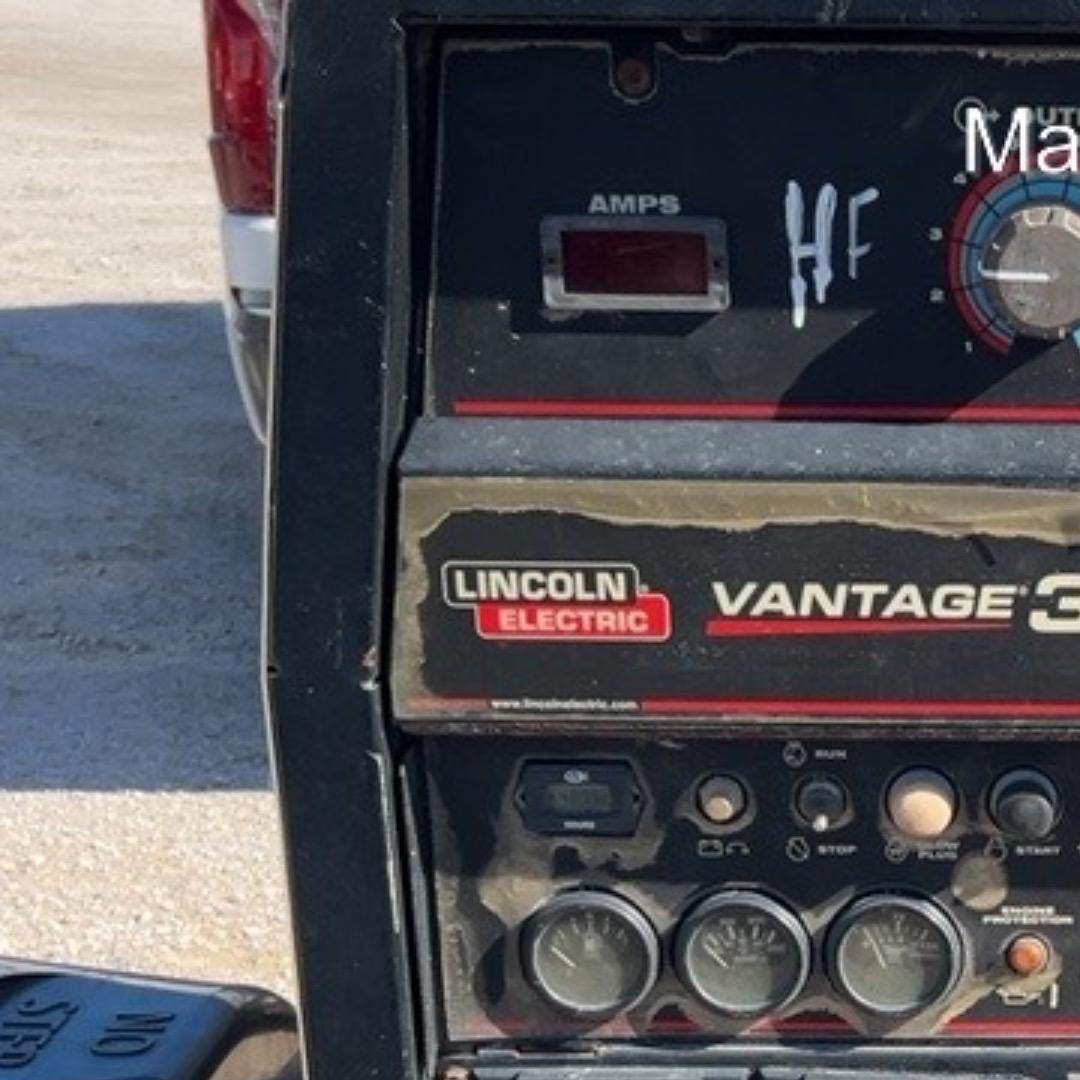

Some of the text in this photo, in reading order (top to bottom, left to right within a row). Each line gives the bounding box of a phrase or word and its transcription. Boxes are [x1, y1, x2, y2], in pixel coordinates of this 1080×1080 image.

[588, 194, 682, 215] AMPS
[454, 570, 628, 601] LINCOLN
[711, 582, 1016, 619] VANTAGE
[498, 608, 650, 633] ELECTRIC
[817, 844, 857, 855] STOP
